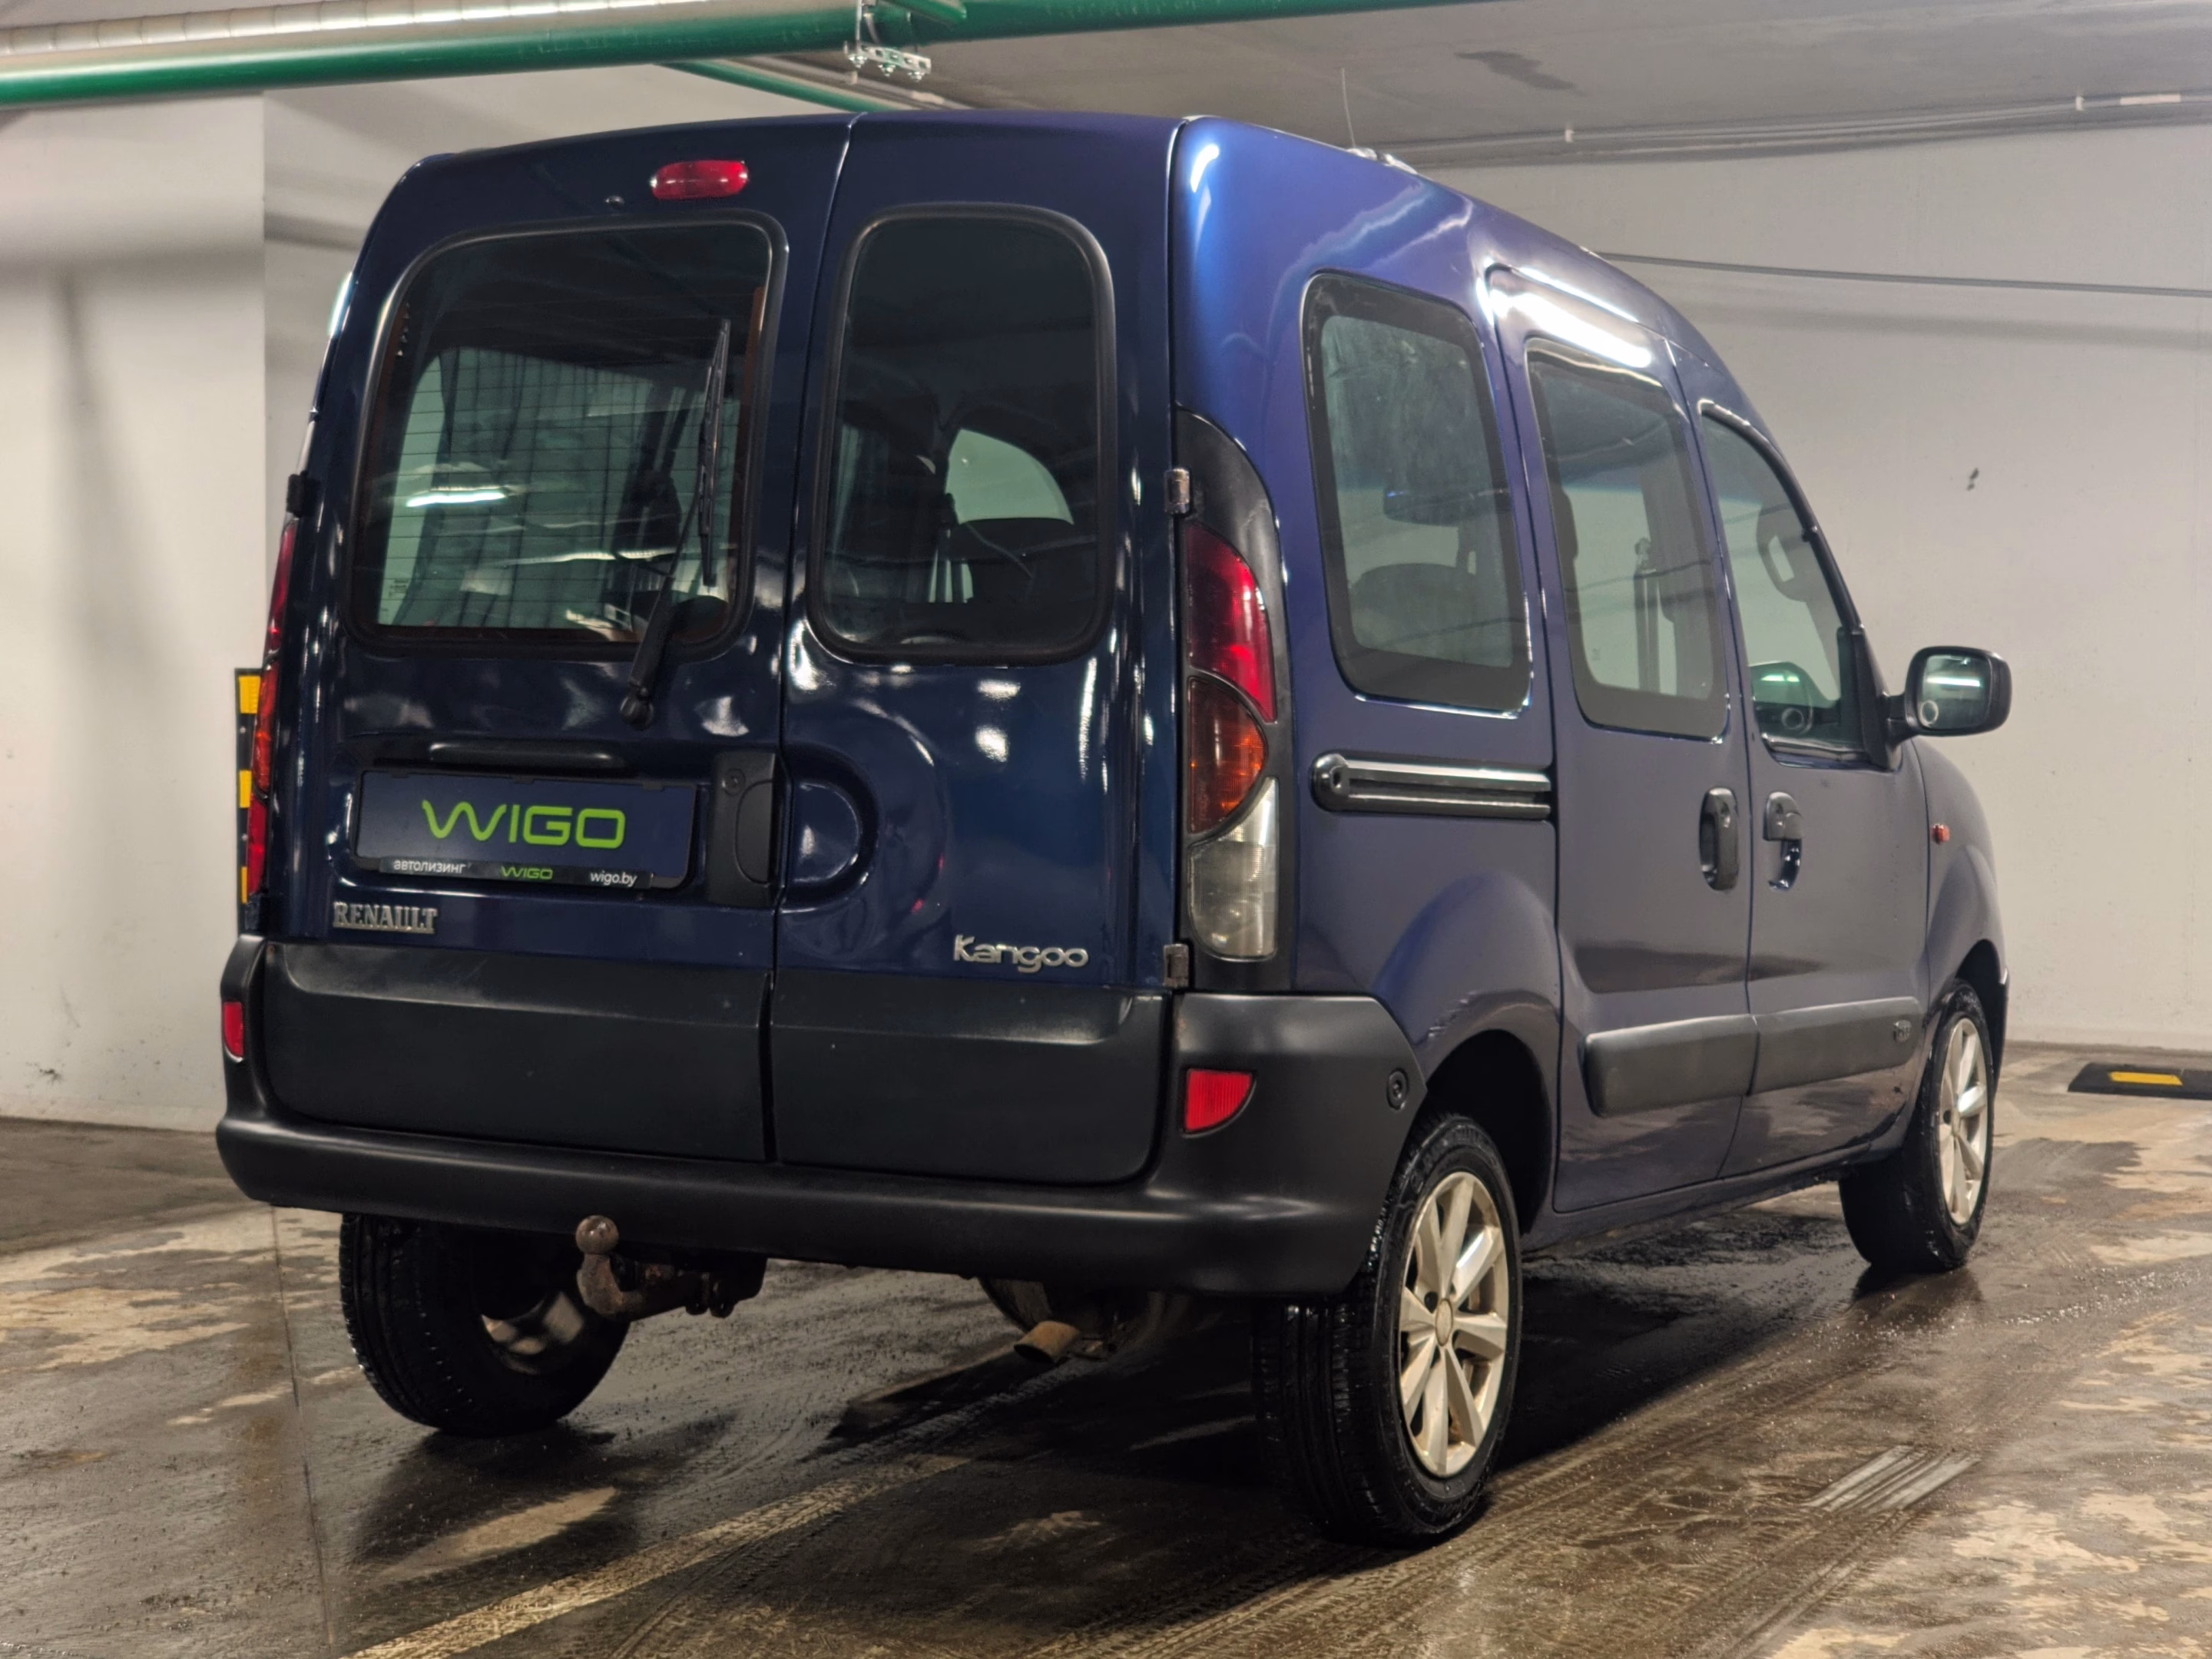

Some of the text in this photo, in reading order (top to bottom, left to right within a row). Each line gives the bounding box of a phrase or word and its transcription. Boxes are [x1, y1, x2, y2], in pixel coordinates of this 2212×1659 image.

[422, 800, 626, 849] WIGO
[393, 858, 465, 874] автолизинг
[500, 866, 553, 880] WIGO
[590, 871, 637, 887] wigo.by
[333, 901, 439, 934] RENAULT
[953, 934, 1089, 973] Kangoo
